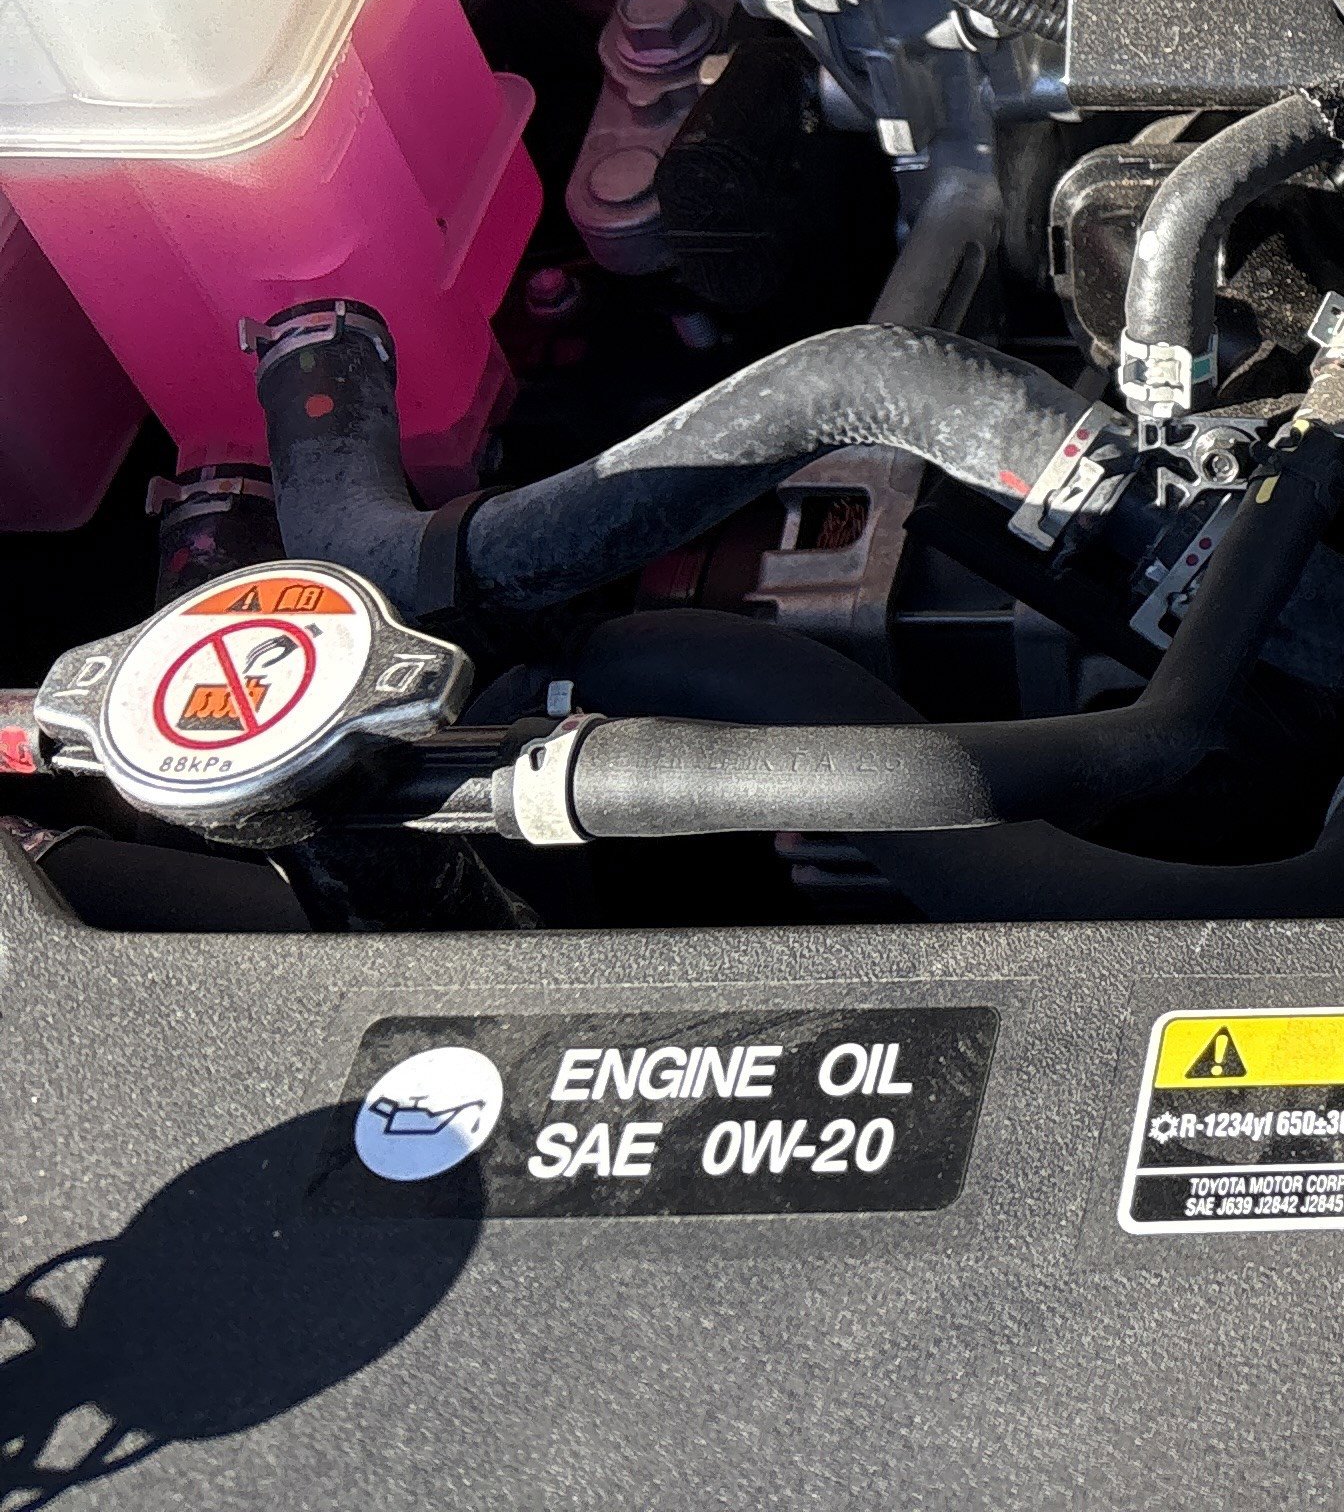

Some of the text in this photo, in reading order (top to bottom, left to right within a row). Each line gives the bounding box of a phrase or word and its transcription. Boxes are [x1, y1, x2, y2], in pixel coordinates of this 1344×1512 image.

[157, 754, 234, 775] 88kPa
[550, 1042, 914, 1101] ENGINE OIL
[1179, 1111, 1275, 1141] R-1234yf
[527, 1117, 896, 1180] SAE 0W-20
[1189, 1176, 1248, 1196] TOYOTA
[1248, 1175, 1302, 1194] MOTOR
[1184, 1194, 1344, 1216] SAE J639 J2842 J2845
